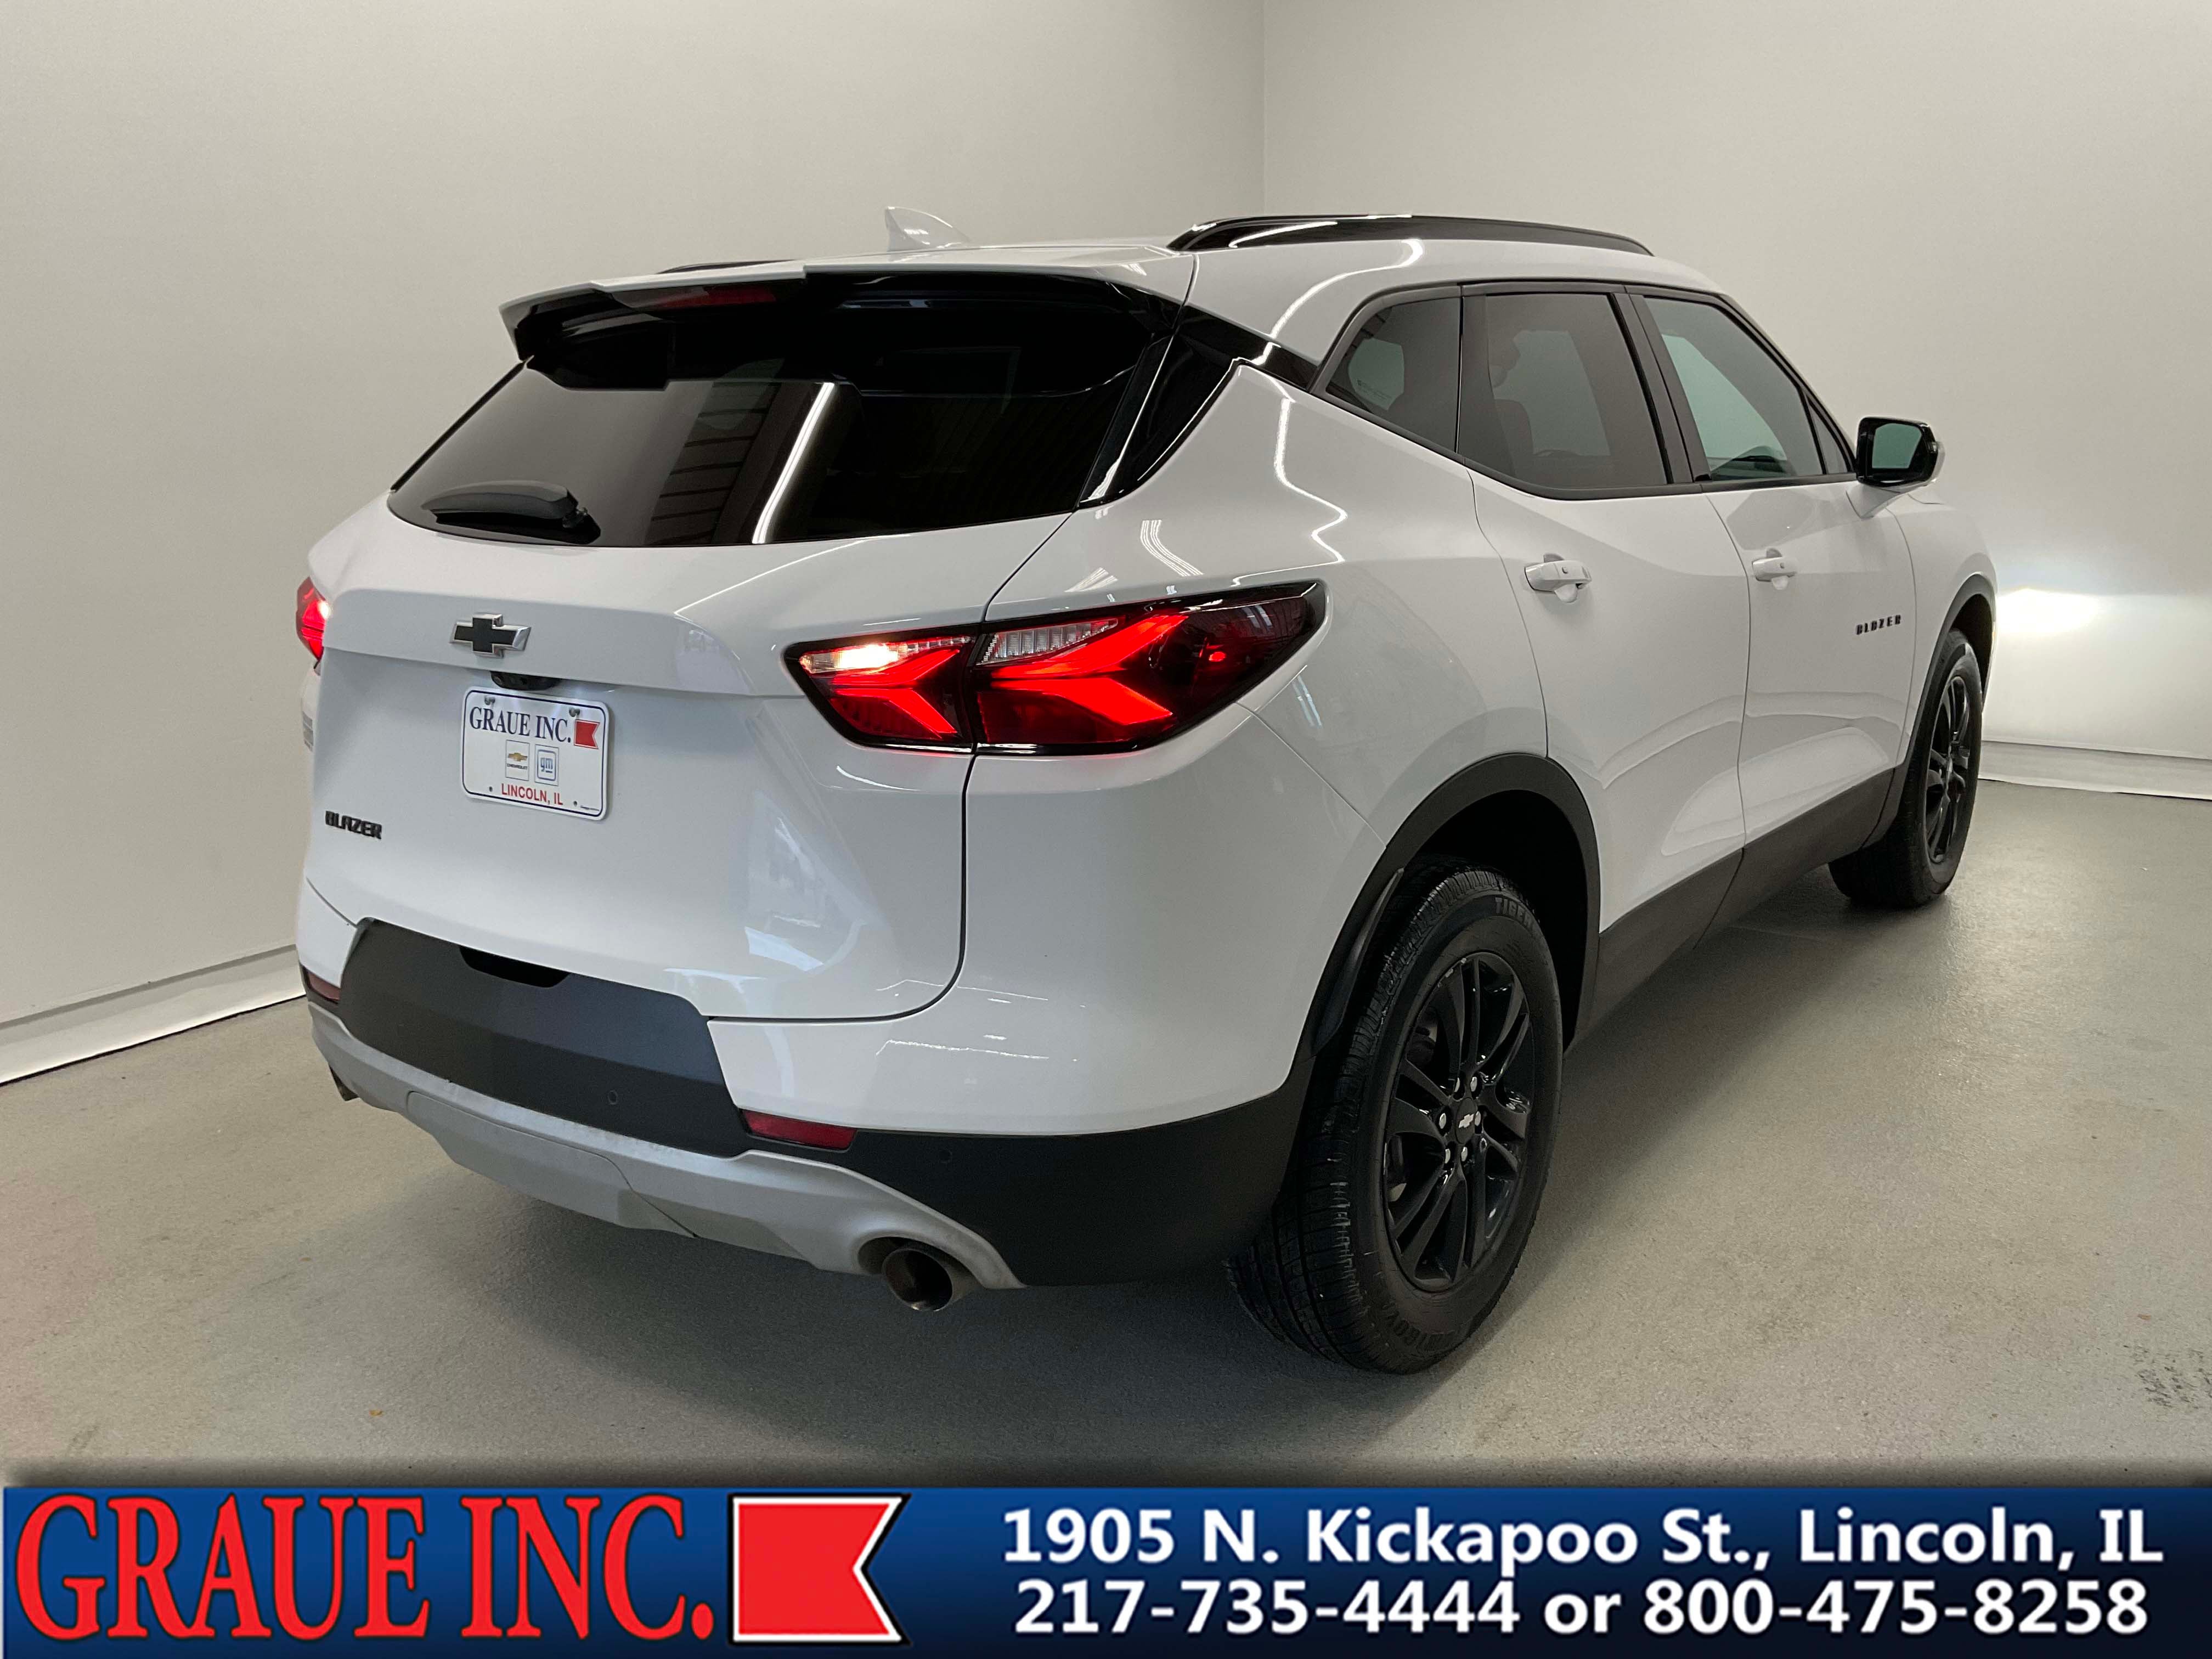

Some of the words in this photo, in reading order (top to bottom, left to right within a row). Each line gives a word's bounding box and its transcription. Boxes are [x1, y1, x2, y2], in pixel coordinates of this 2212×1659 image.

[1856, 614, 1901, 635] BLAZER
[469, 706, 531, 737] GRAUE
[534, 715, 572, 743] INC.
[501, 783, 550, 805] LINCOLN,
[554, 793, 563, 805] IL
[325, 810, 382, 840] BLAZER
